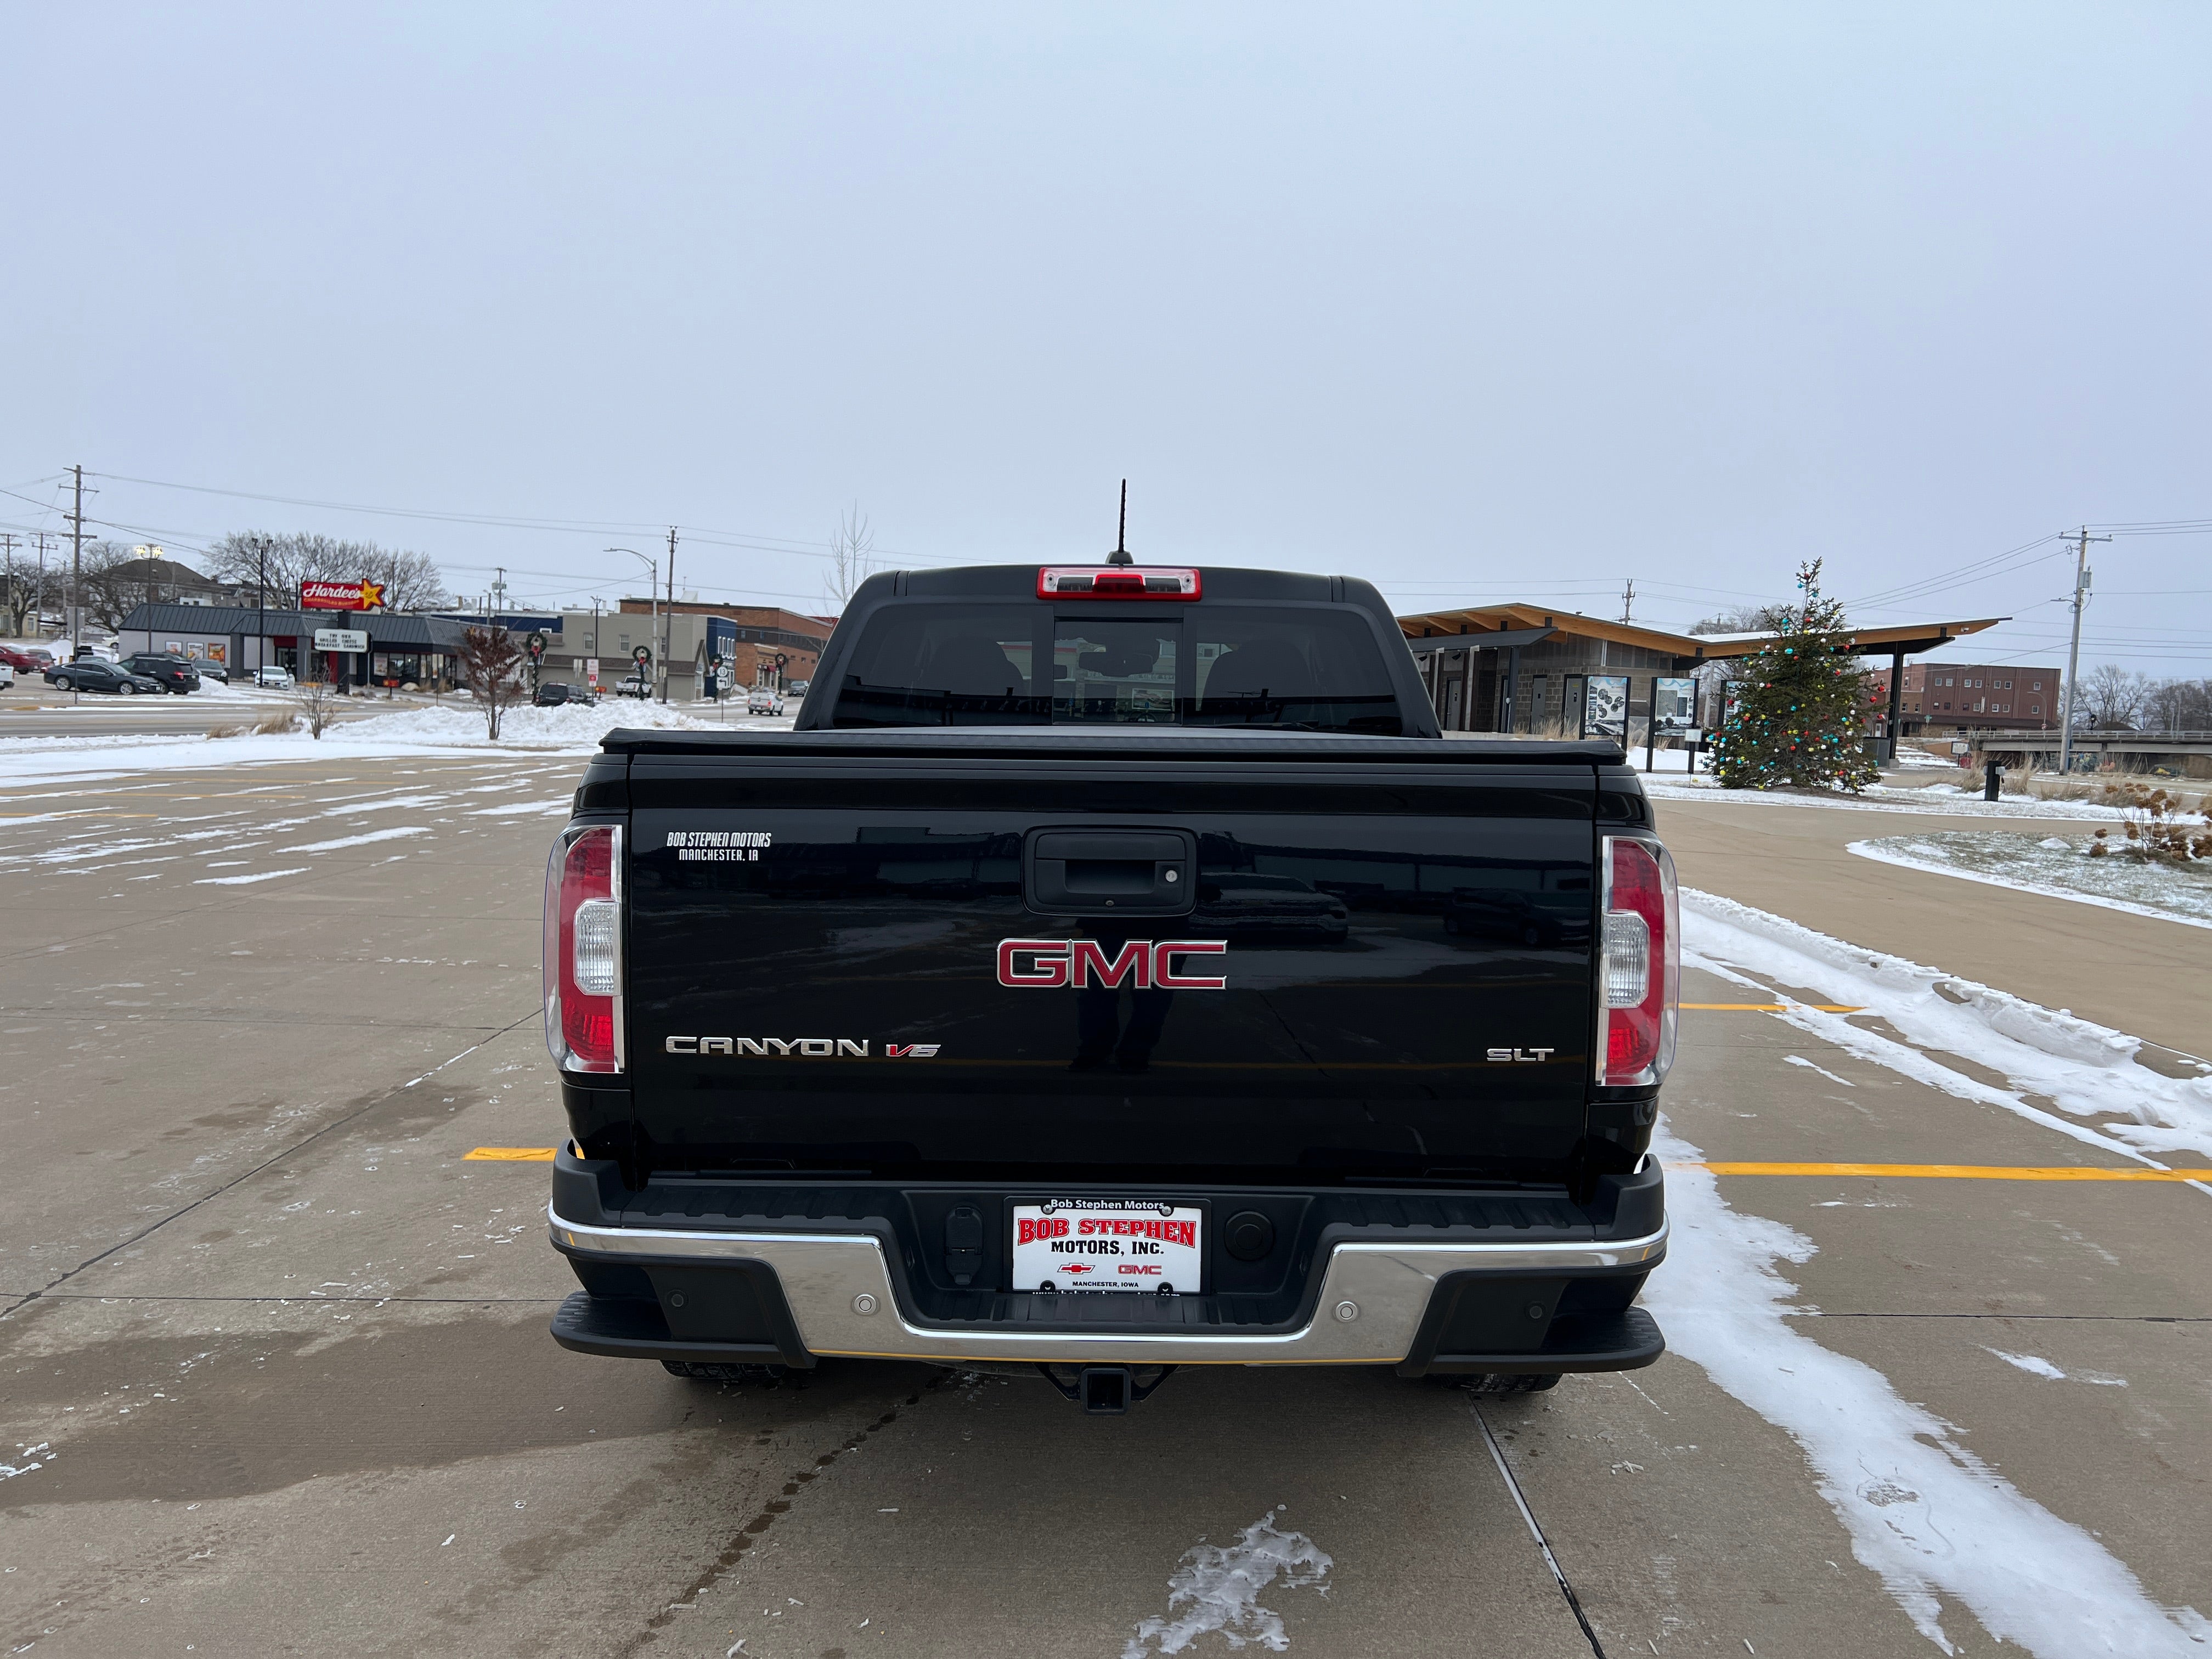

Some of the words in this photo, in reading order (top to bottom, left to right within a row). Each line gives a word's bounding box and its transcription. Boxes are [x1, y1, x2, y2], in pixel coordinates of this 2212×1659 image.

[303, 584, 360, 599] Hardee's
[667, 832, 686, 847] BOB
[687, 832, 729, 847] STEPHEN
[730, 832, 772, 847] MOTORS
[748, 849, 758, 861] IA
[996, 938, 1228, 990] GMC
[665, 1036, 869, 1057] CANYON
[886, 1044, 941, 1057] V6
[1487, 1048, 1554, 1061] SLT
[1051, 1199, 1073, 1208] Bob
[1075, 1200, 1121, 1211] Stephen
[1125, 1201, 1164, 1209] Motors
[1018, 1218, 1069, 1246] BOB
[1079, 1218, 1196, 1249] STEPHEN
[1051, 1240, 1125, 1256] MOTORS,
[1132, 1242, 1164, 1255] INC.
[1118, 1264, 1162, 1276] GMC
